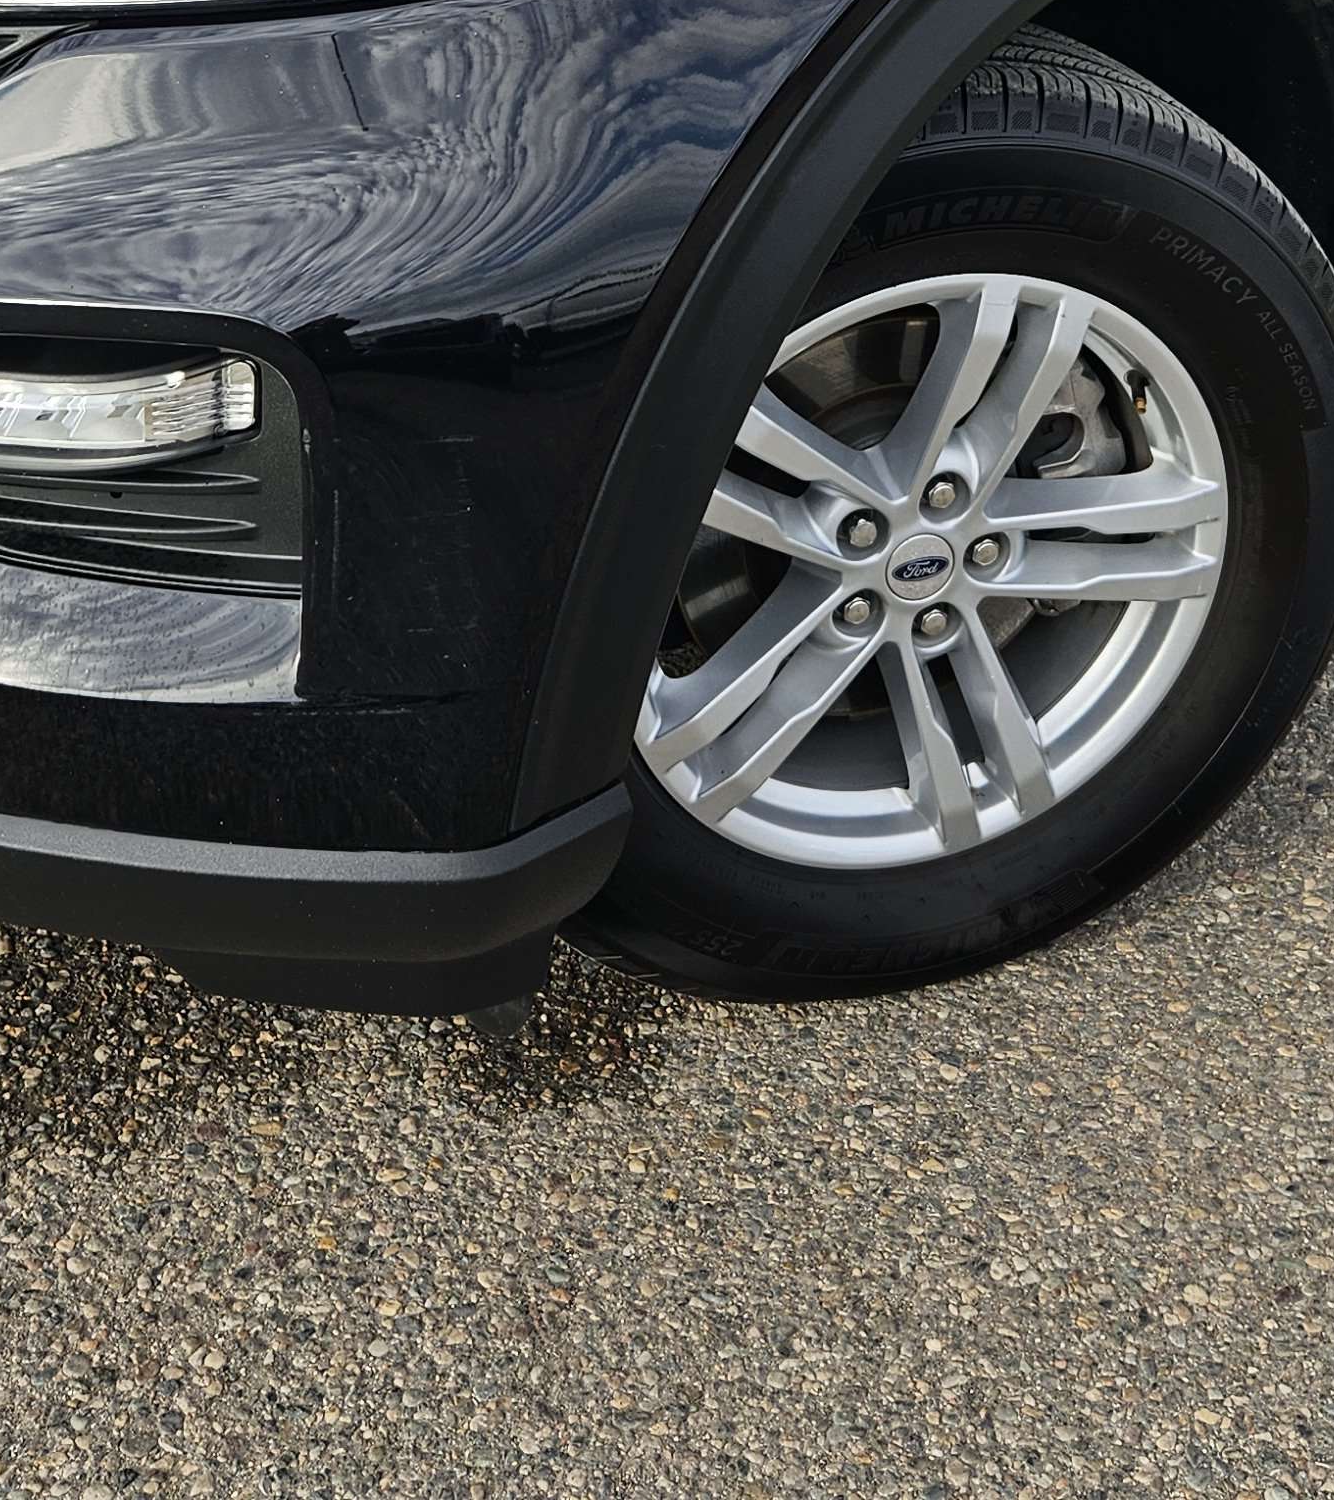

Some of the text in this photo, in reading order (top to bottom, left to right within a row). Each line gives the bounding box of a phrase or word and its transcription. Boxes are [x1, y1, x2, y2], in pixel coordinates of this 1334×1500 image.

[882, 194, 1125, 242] MICHELIN
[1147, 226, 1319, 412] PRIMACY ALL SEASON
[902, 560, 940, 579] Ford
